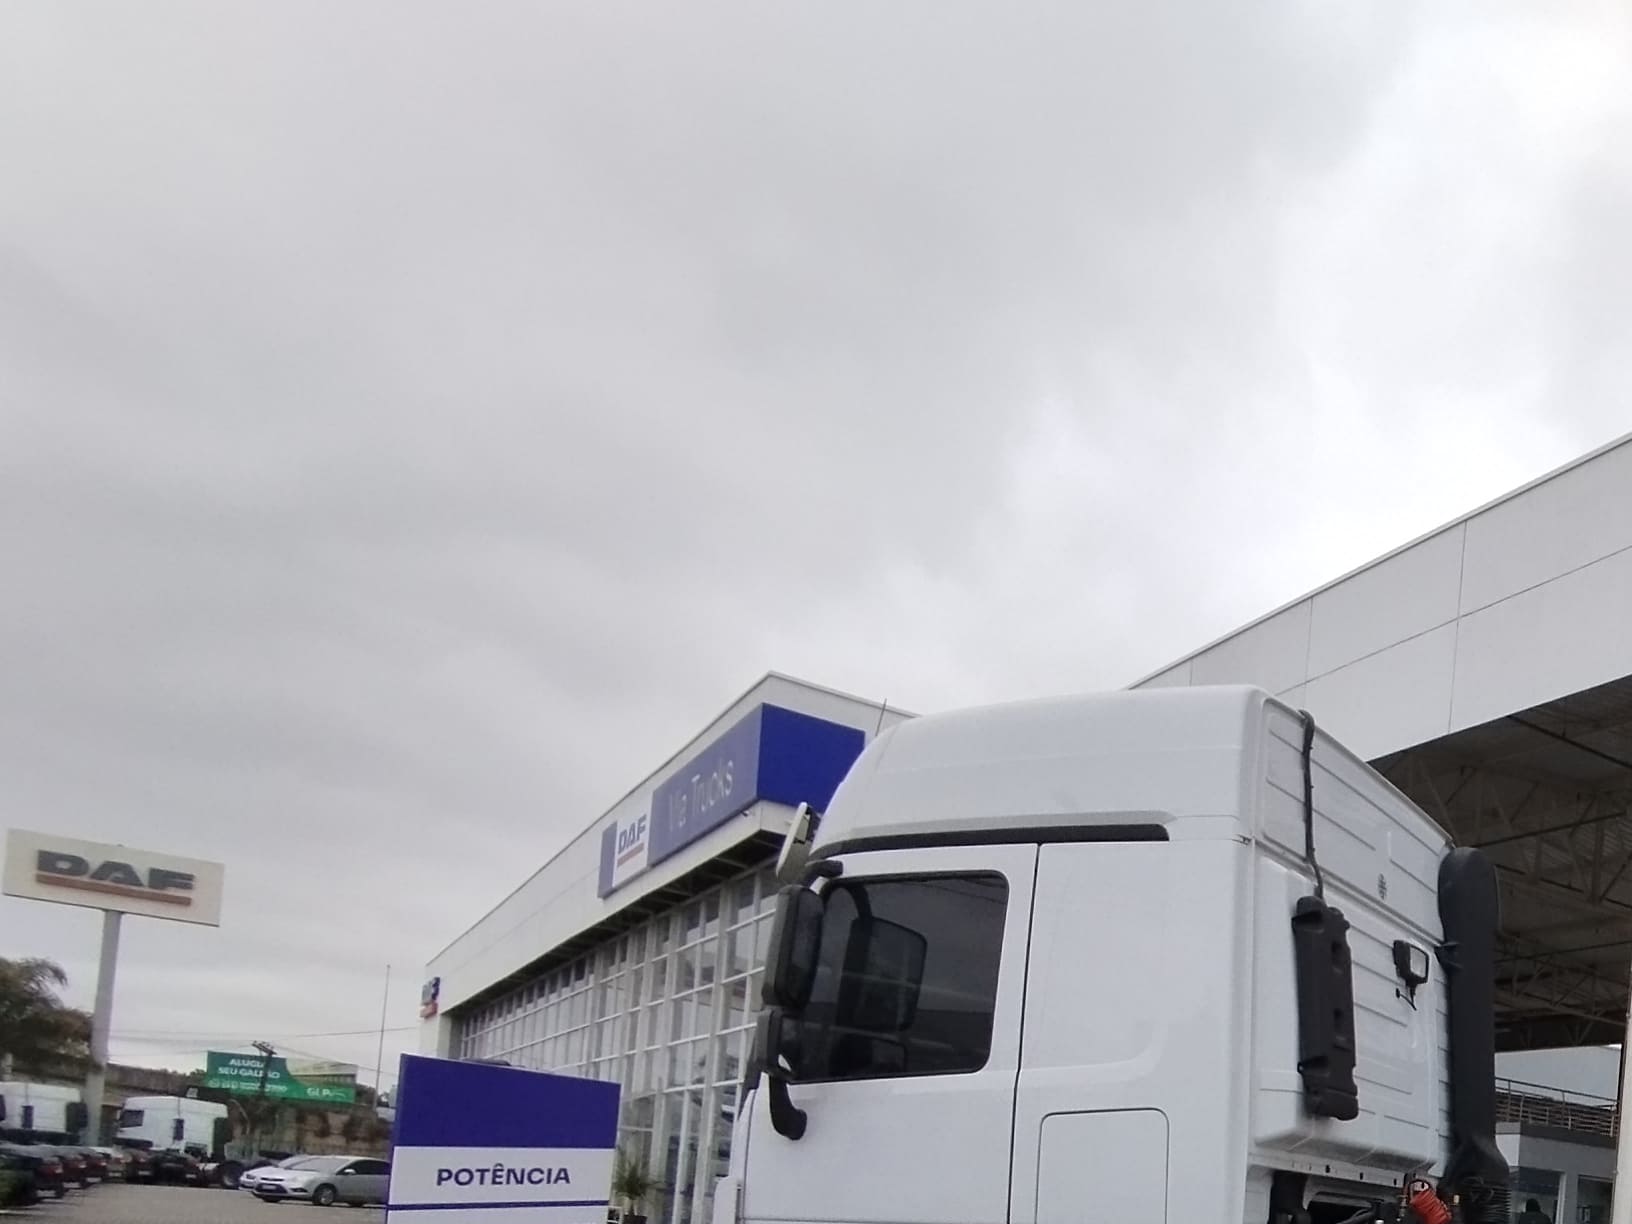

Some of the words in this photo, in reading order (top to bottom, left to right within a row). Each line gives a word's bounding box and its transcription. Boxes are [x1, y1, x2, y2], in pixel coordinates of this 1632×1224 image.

[618, 814, 647, 855] DAF
[36, 848, 195, 891] DAF
[217, 1065, 238, 1076] SEU
[436, 1163, 571, 1187] POTÊNCIA
